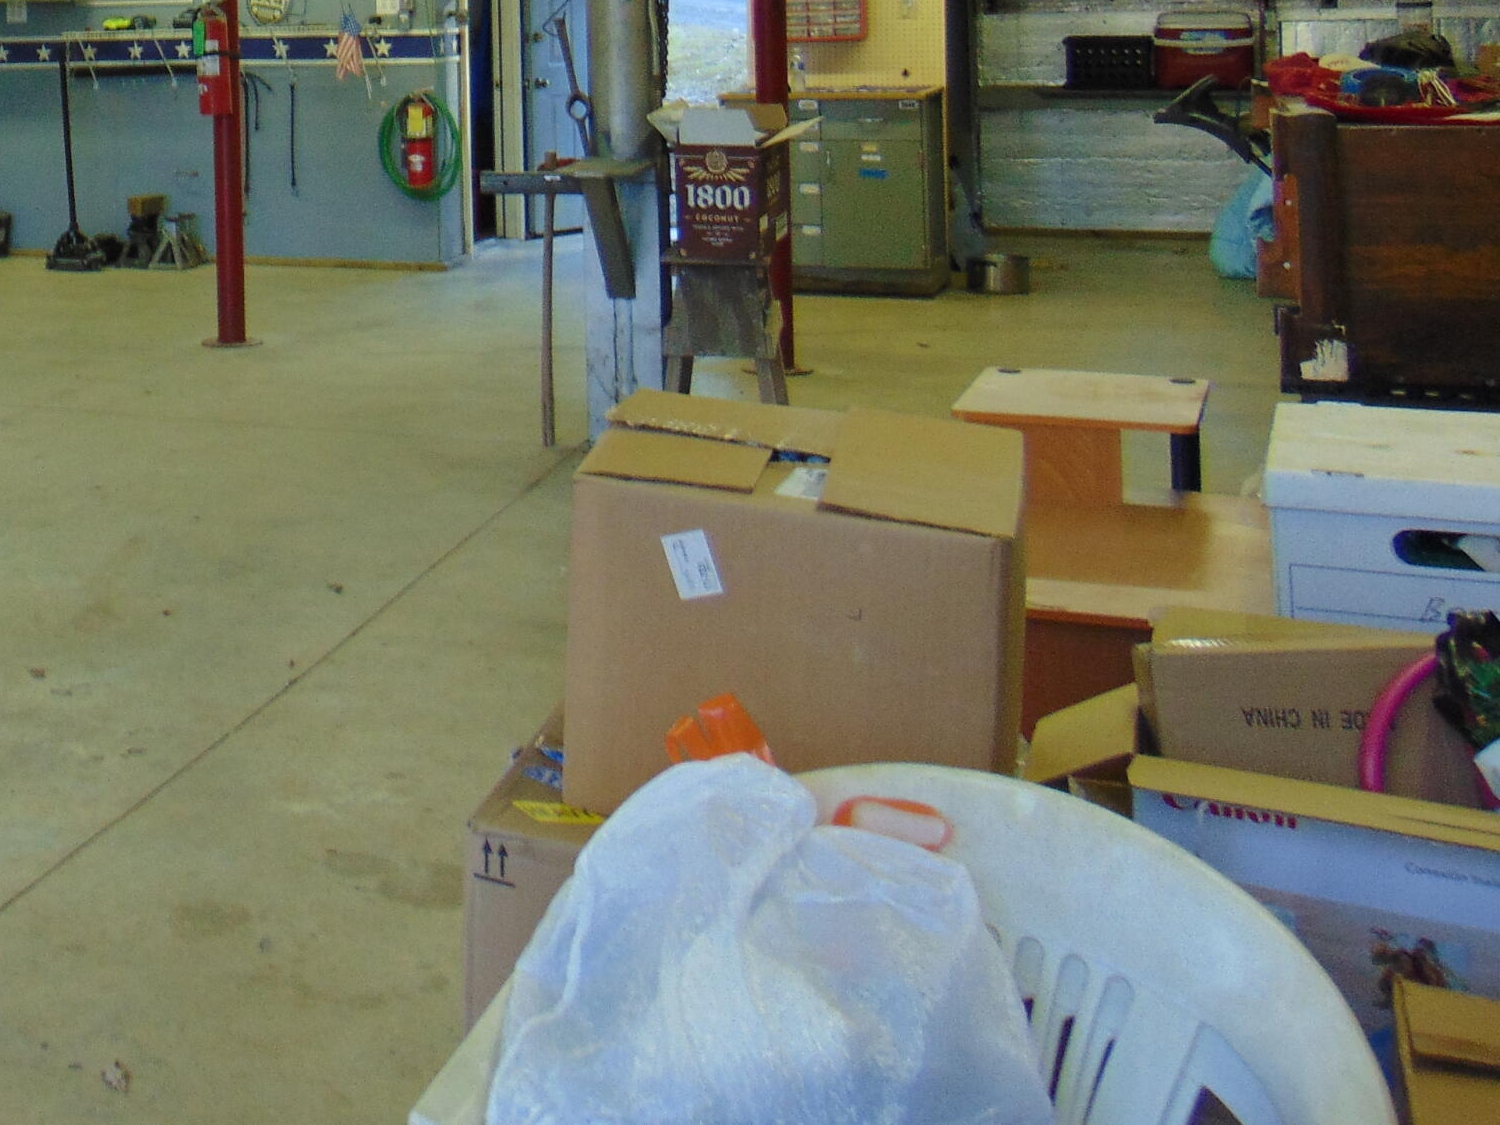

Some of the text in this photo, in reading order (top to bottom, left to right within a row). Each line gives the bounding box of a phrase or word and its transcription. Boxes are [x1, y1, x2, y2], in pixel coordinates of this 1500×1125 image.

[685, 183, 750, 210] 1800
[695, 213, 740, 223] COCONUT
[1241, 707, 1302, 728] CHINA
[1310, 709, 1330, 729] IN
